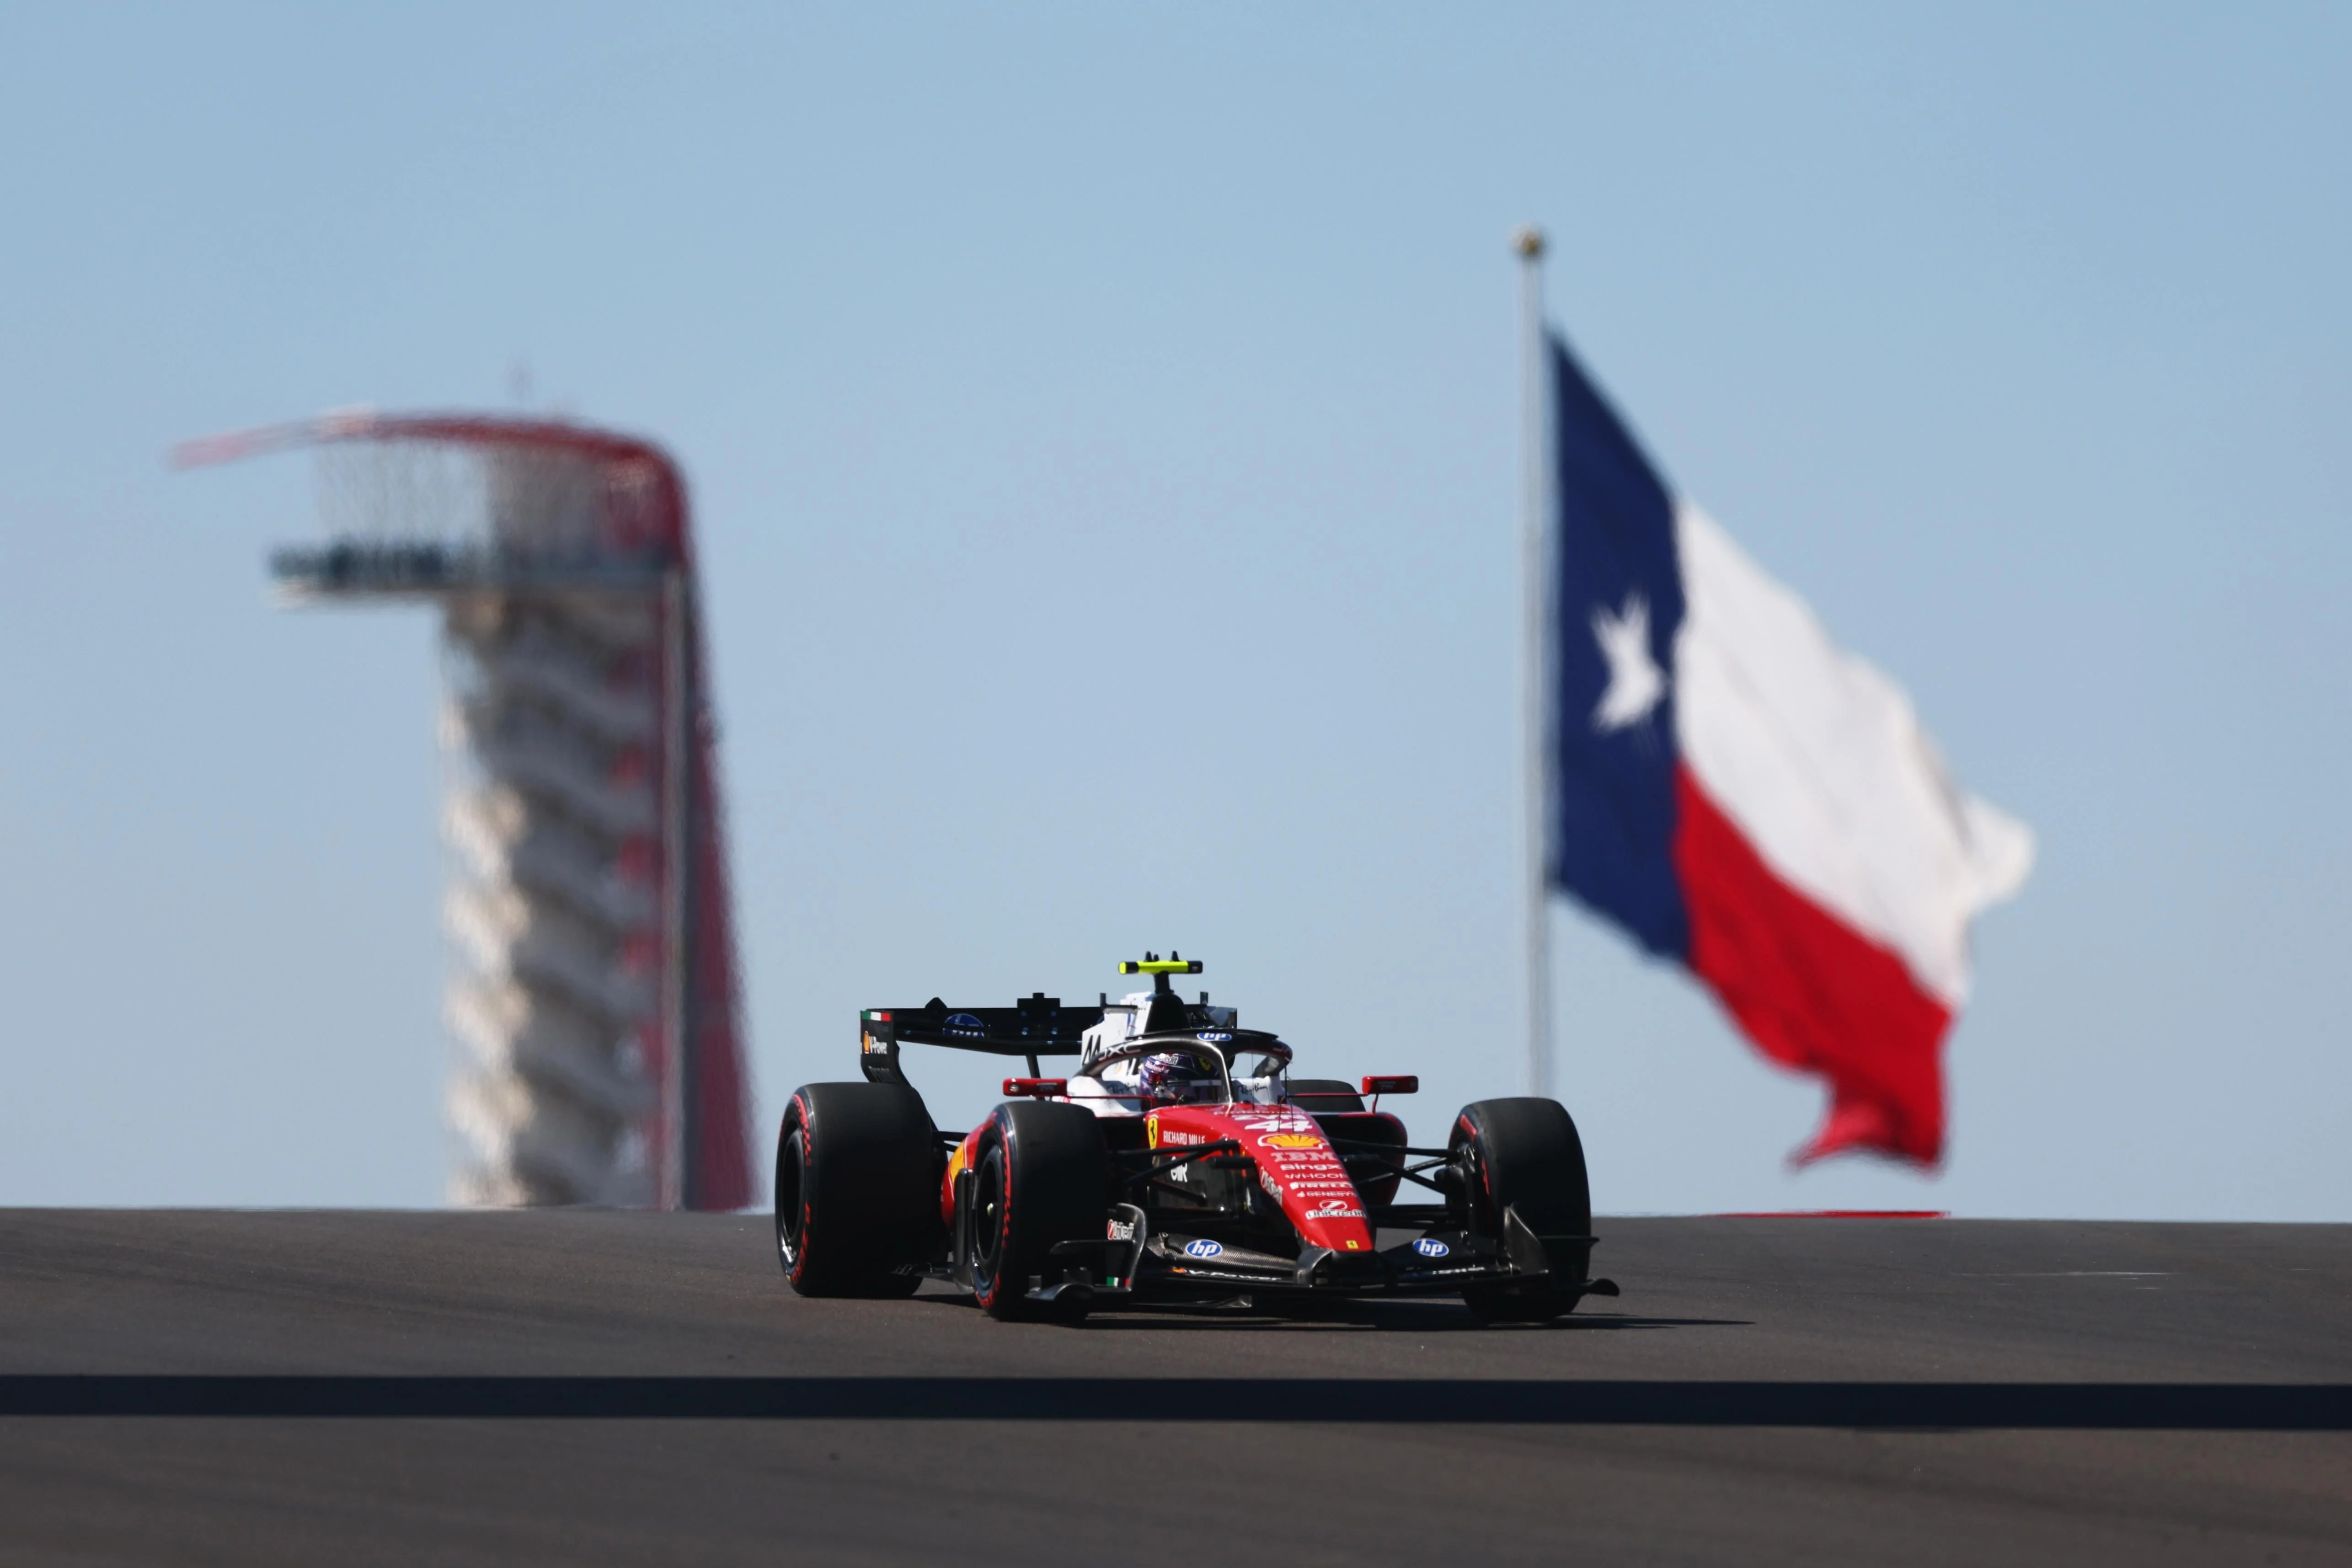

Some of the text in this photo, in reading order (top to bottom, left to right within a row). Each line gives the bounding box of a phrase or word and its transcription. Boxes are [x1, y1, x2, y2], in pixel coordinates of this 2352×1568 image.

[1245, 1120, 1313, 1132] 44
[1163, 1130, 1187, 1145] RICHARD
[1271, 1151, 1339, 1162] IBM
[1289, 1181, 1355, 1190] PIRELLI
[1305, 1209, 1367, 1220] UniCredit
[1192, 1240, 1217, 1258] hp
[1419, 1239, 1443, 1257] hp
